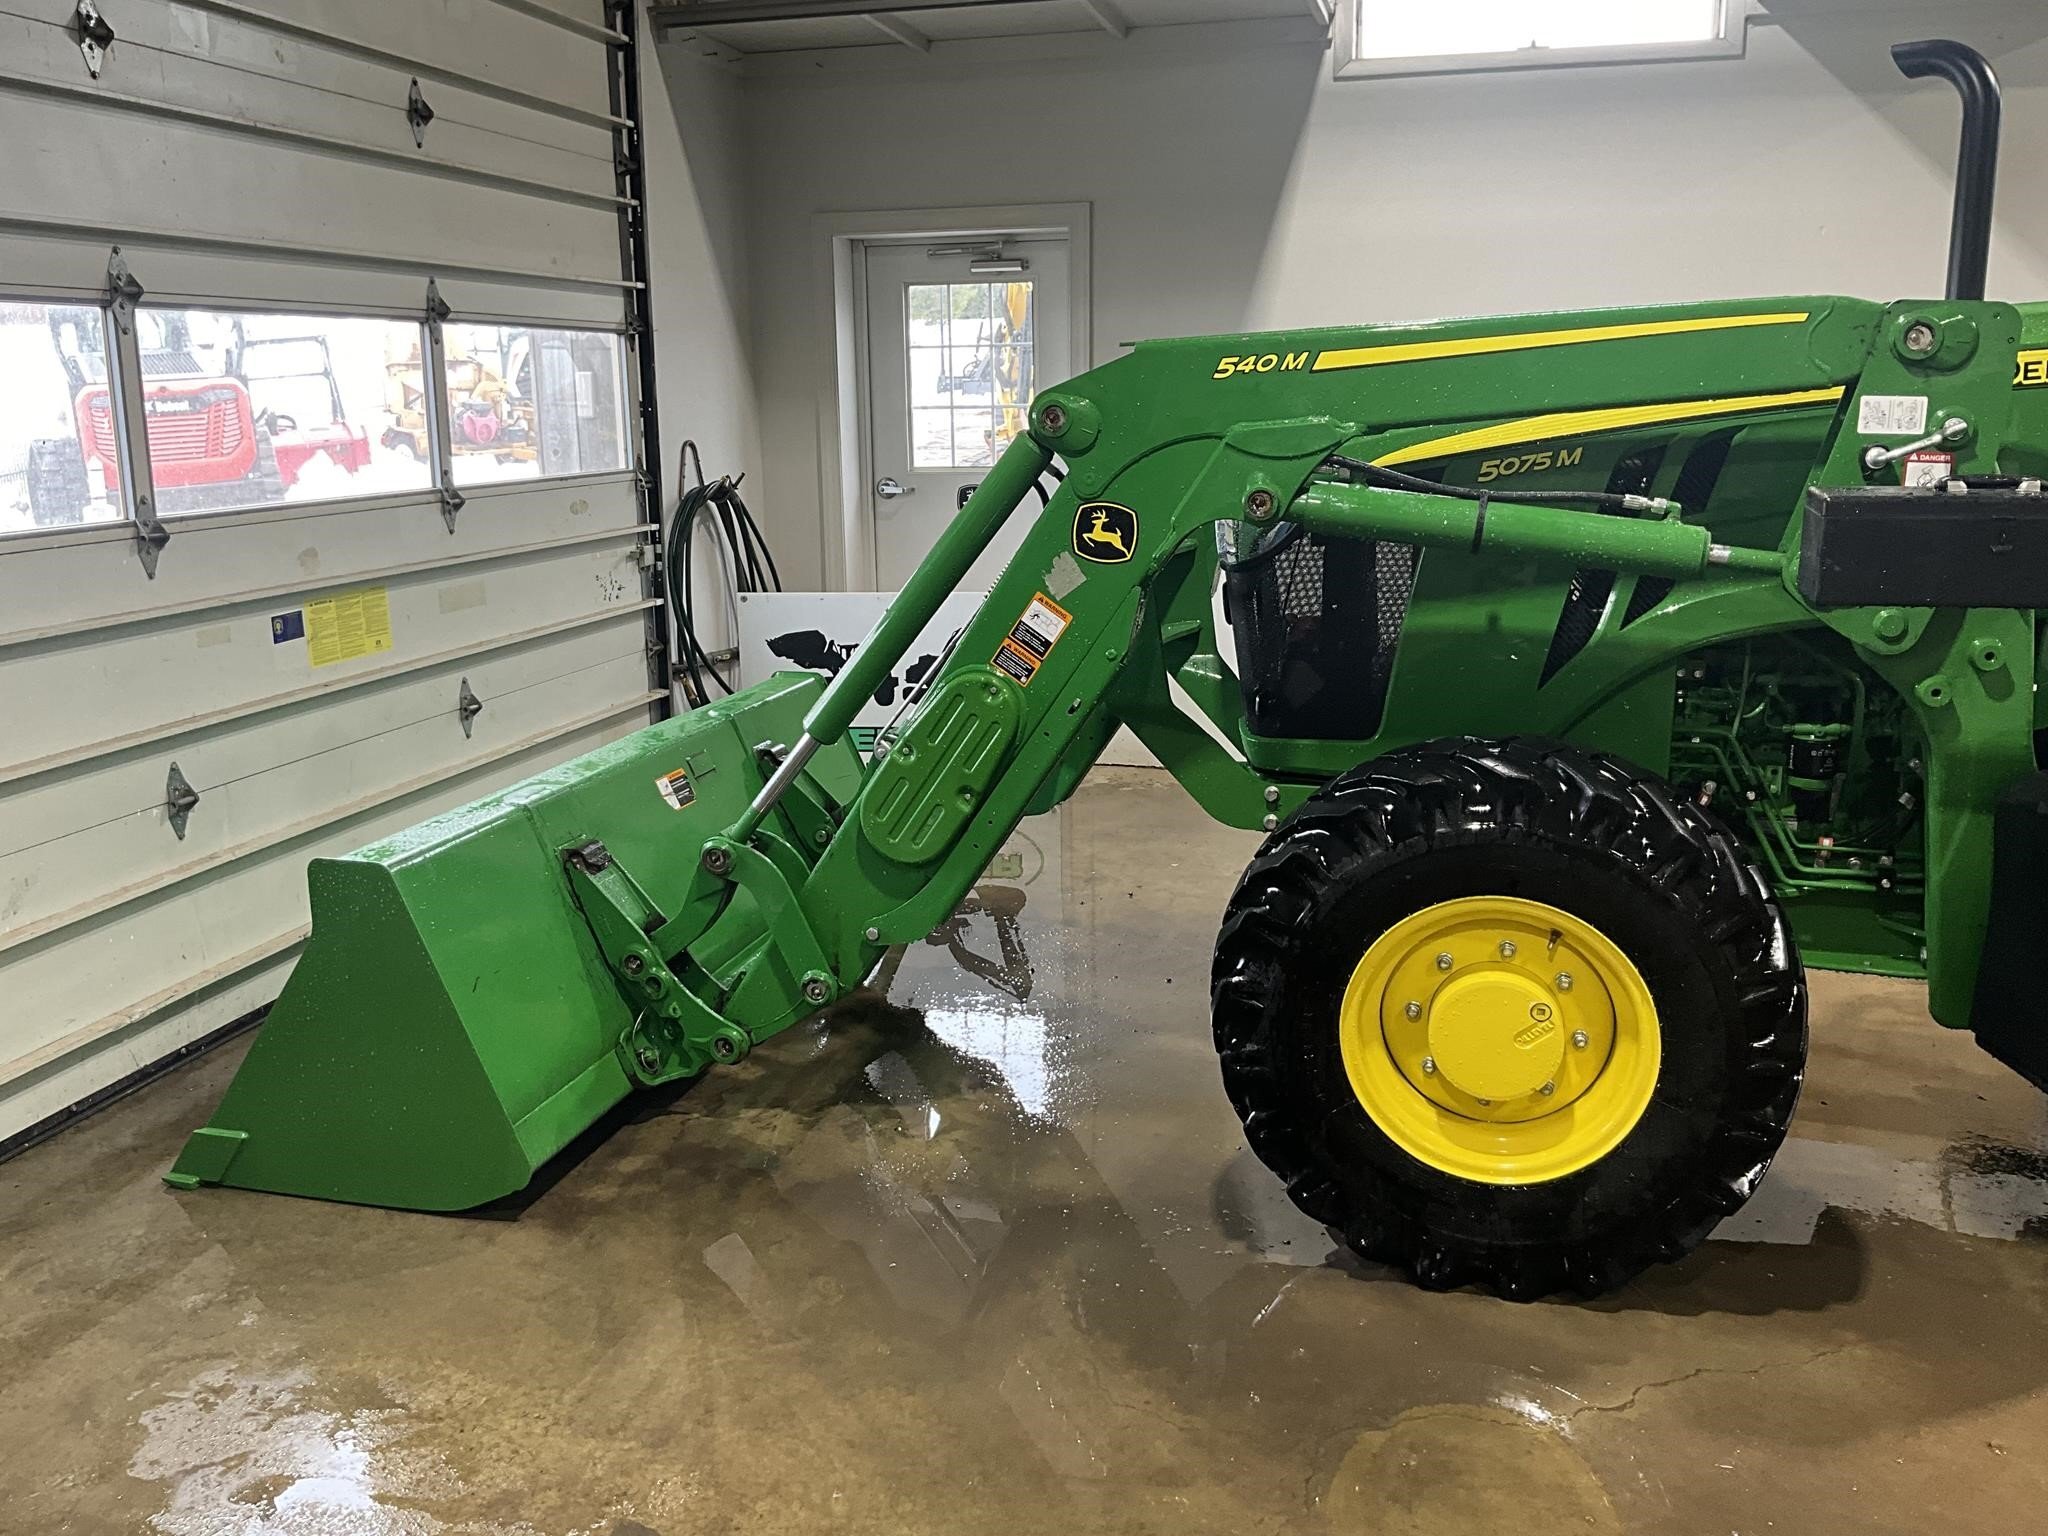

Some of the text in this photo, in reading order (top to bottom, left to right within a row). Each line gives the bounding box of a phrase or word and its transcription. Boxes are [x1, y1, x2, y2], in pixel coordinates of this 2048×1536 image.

[1212, 350, 1310, 379] 540 M
[1477, 446, 1583, 482] 5075 M
[1920, 453, 1951, 462] DANGER
[1043, 600, 1067, 620] WARNING
[1013, 646, 1037, 666] WARNING
